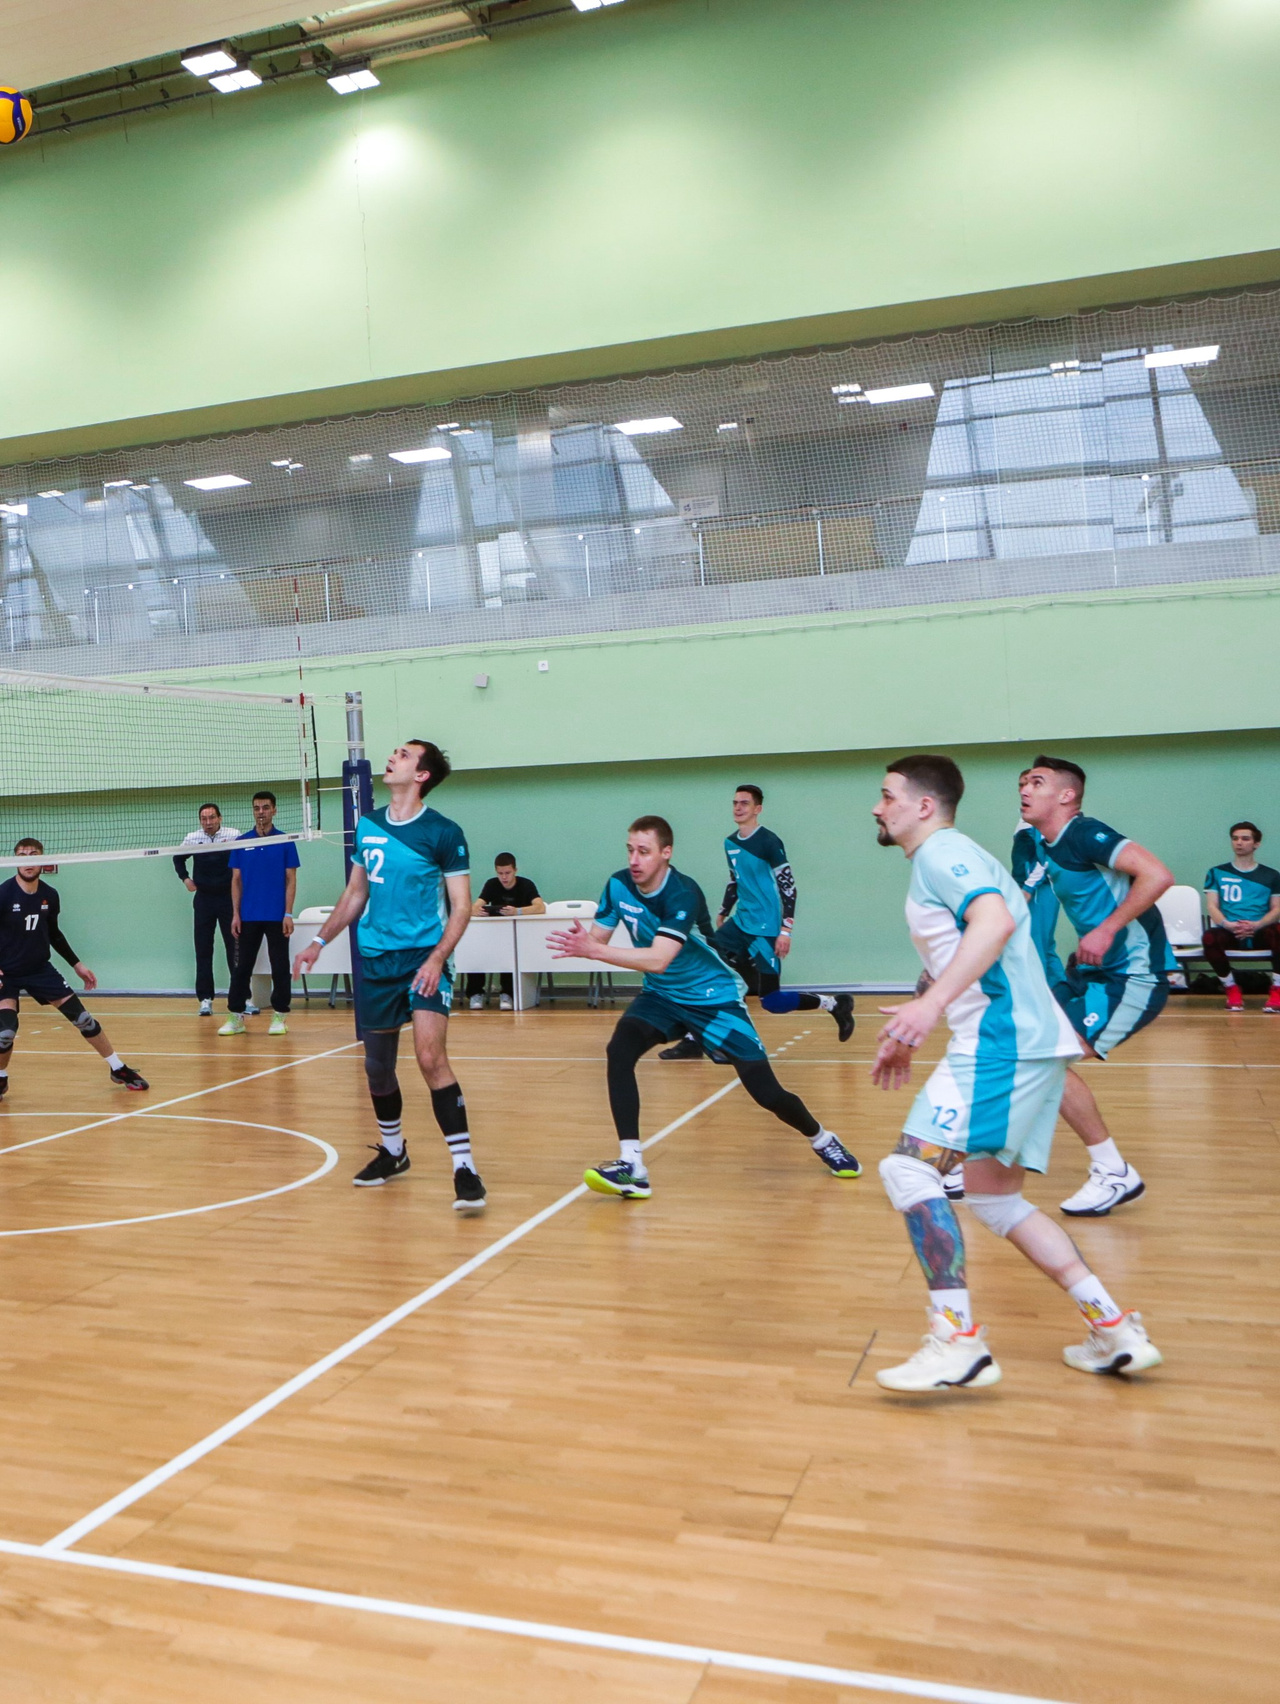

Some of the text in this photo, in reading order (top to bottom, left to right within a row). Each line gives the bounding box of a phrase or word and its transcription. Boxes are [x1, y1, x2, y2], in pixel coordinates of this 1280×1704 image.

[362, 848, 385, 884] 12
[1220, 884, 1242, 902] 10
[24, 914, 39, 931] 17
[1083, 1012, 1100, 1027] 8
[931, 1105, 959, 1131] 12
